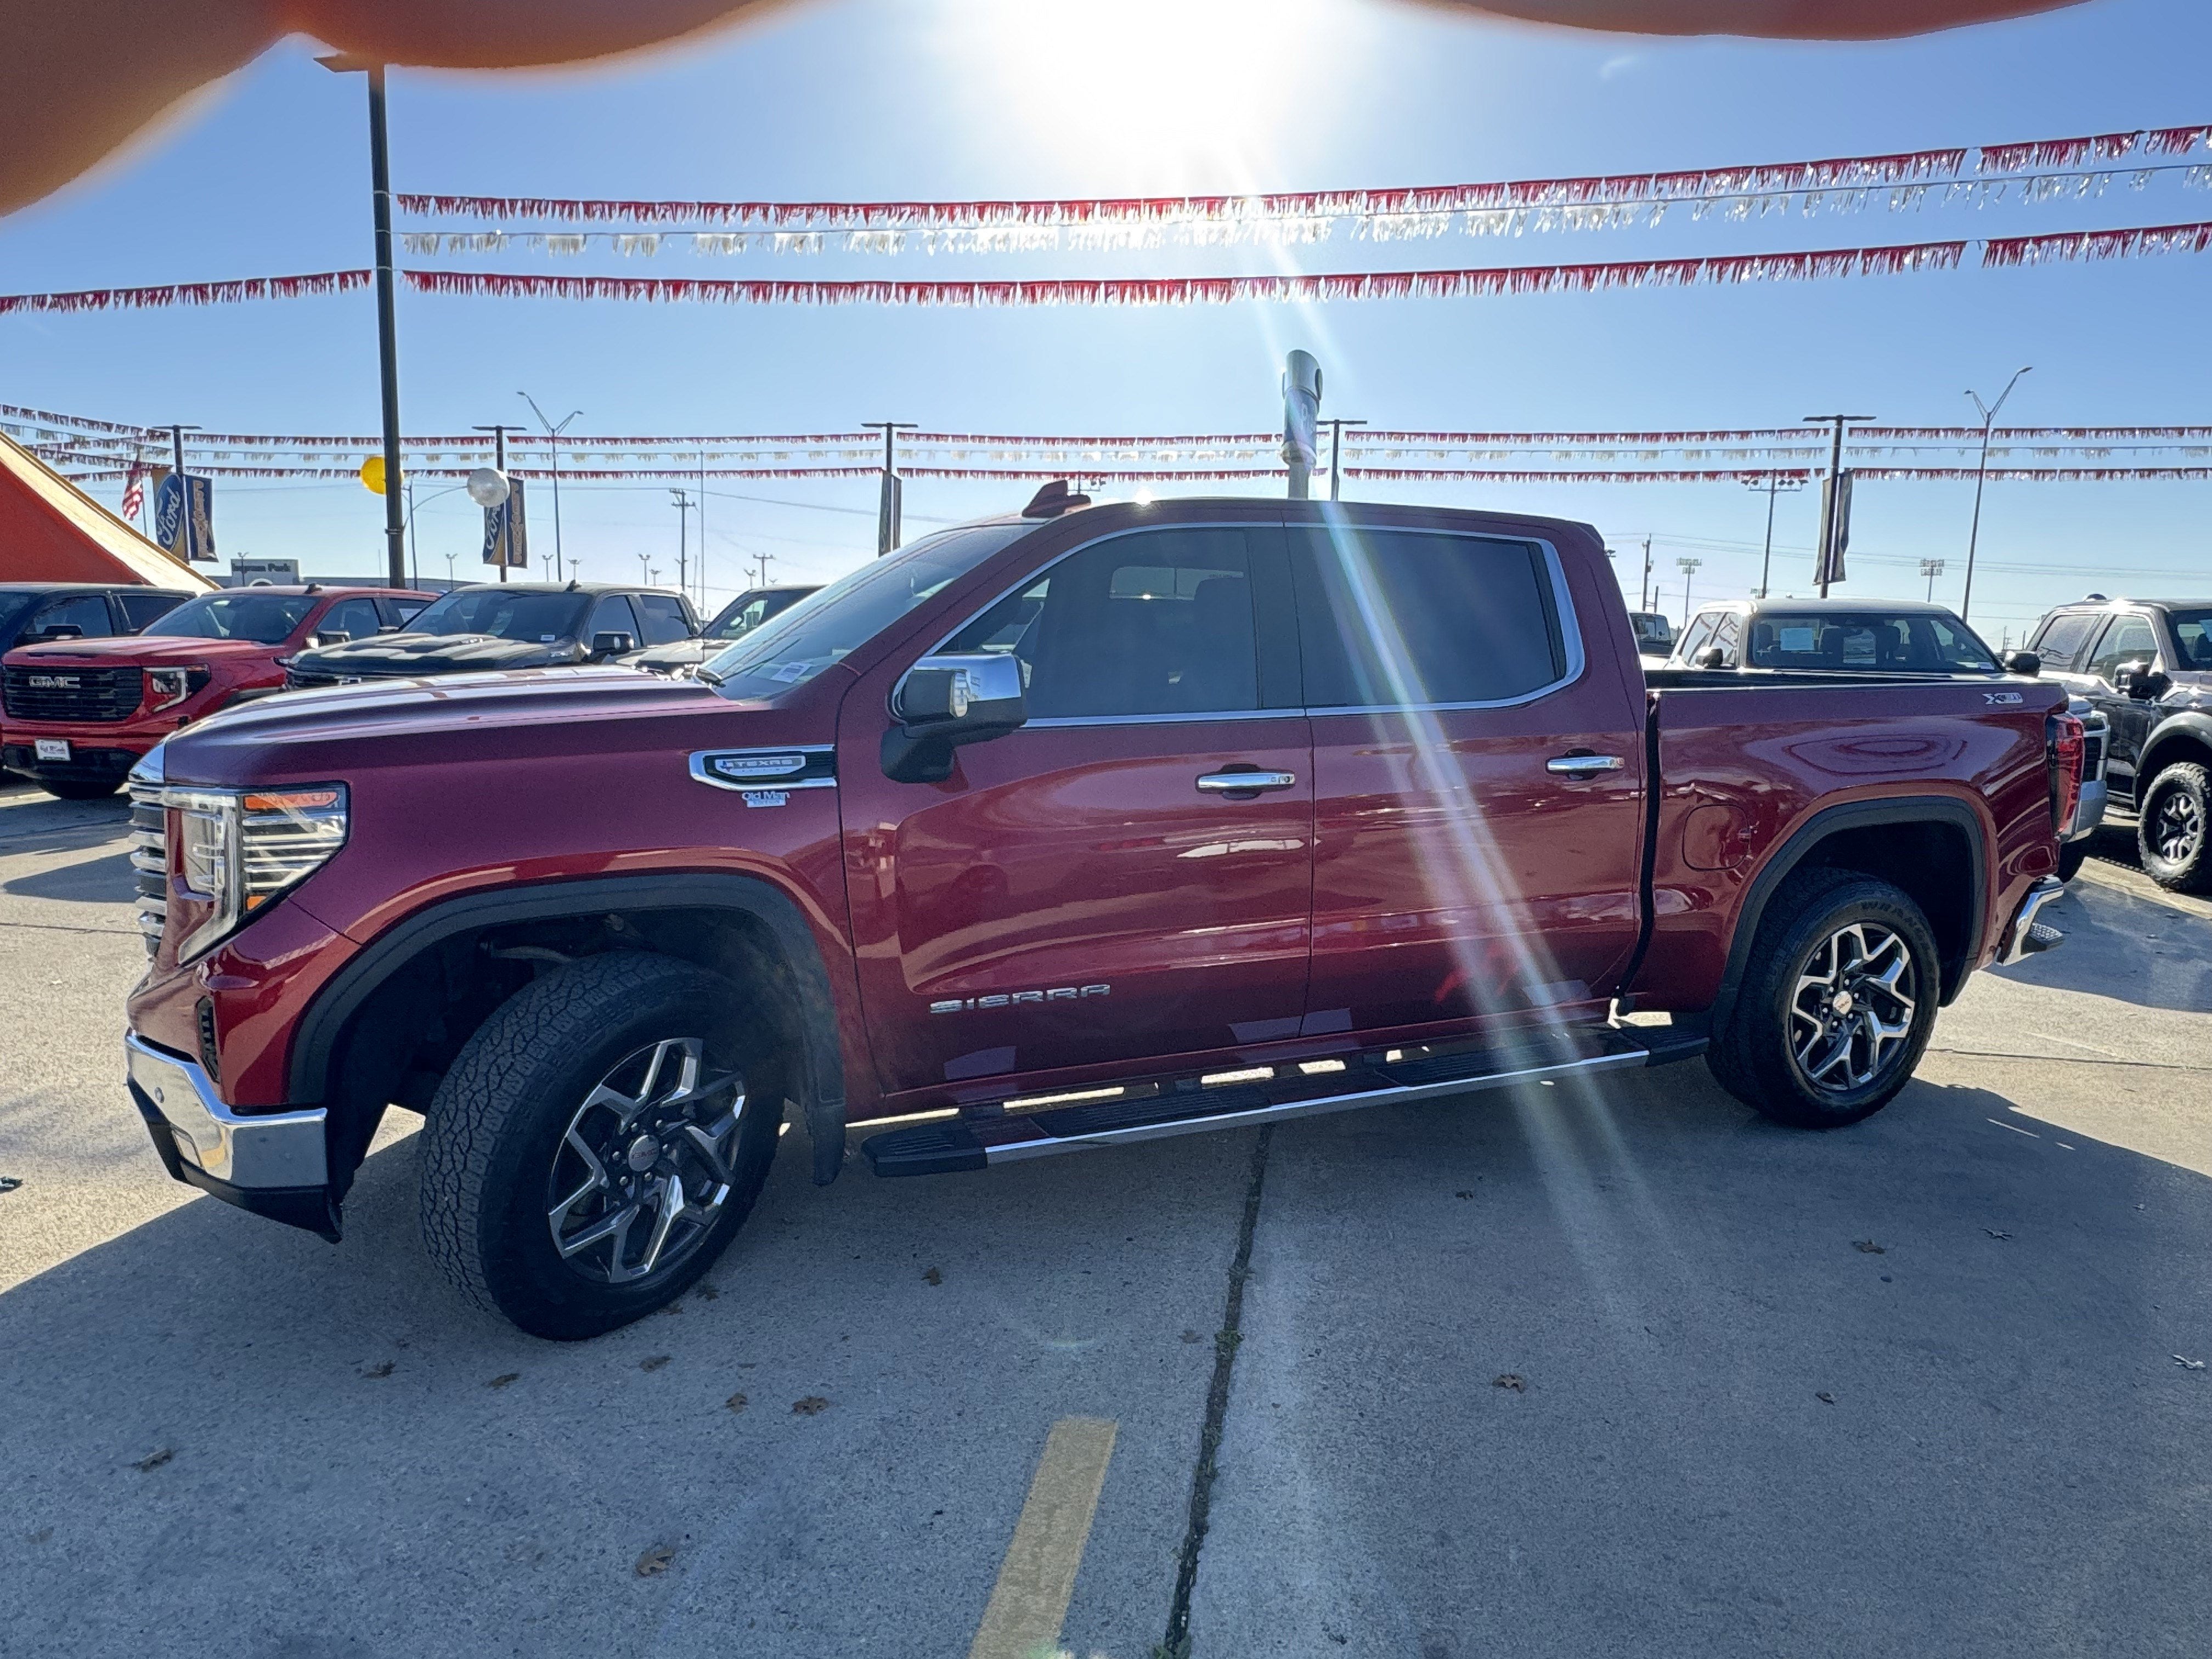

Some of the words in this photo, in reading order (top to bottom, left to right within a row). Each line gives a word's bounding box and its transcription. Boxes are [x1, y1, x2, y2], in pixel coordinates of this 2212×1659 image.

[157, 486, 181, 545] Ford
[29, 676, 81, 689] GMC
[733, 759, 793, 768] TEXAS
[929, 984, 1111, 1014] SIERRA
